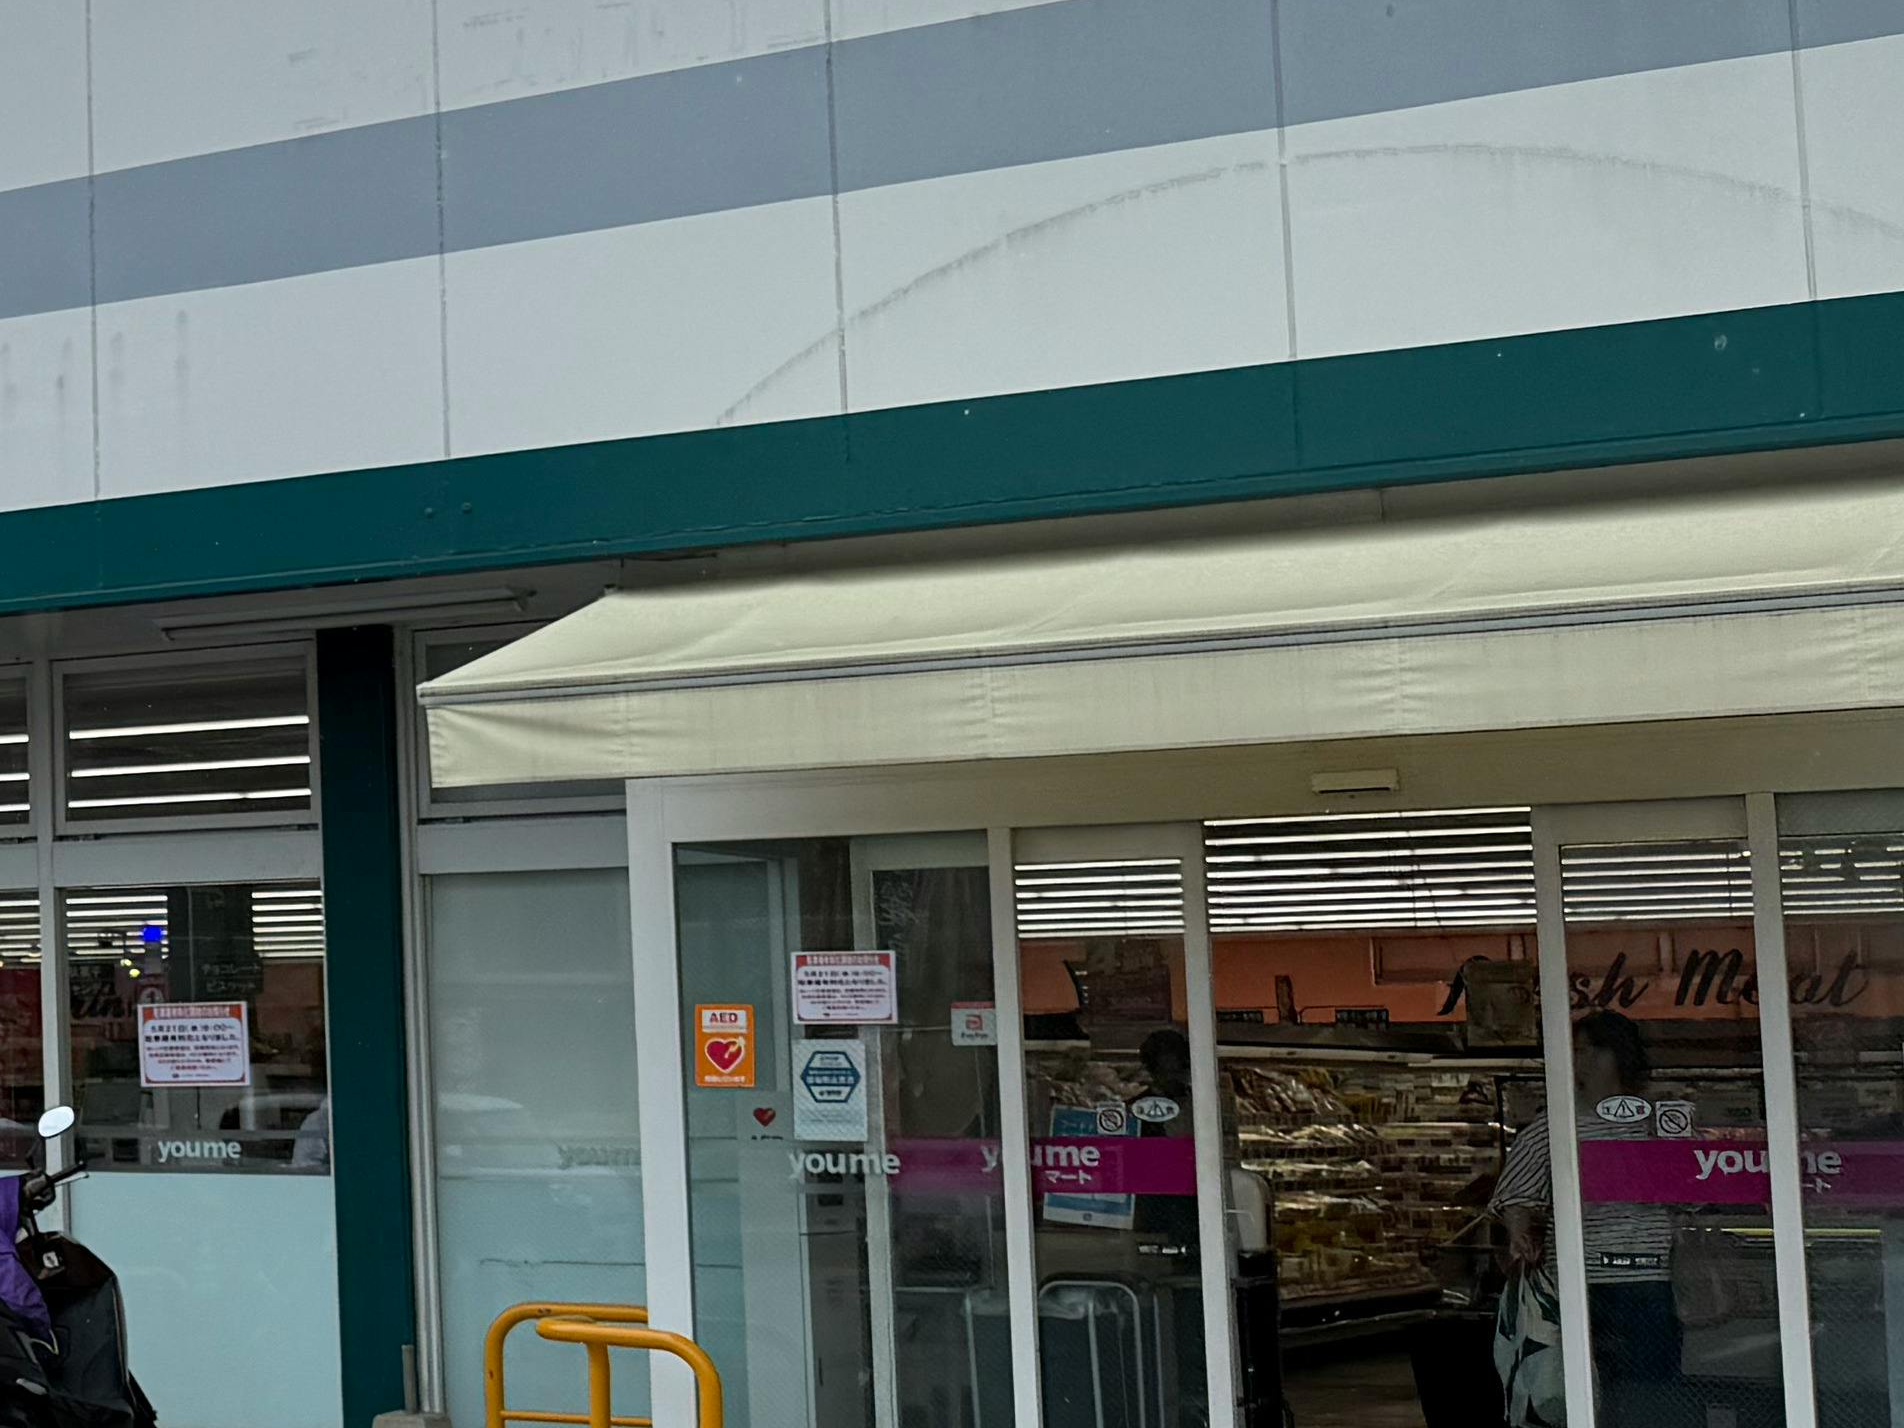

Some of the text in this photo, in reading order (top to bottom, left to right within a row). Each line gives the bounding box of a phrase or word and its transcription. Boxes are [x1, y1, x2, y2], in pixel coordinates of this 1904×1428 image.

[709, 1012, 738, 1023] AED
[158, 1139, 242, 1163] youme
[786, 1149, 902, 1180] youme
[1045, 1169, 1092, 1185] マート
